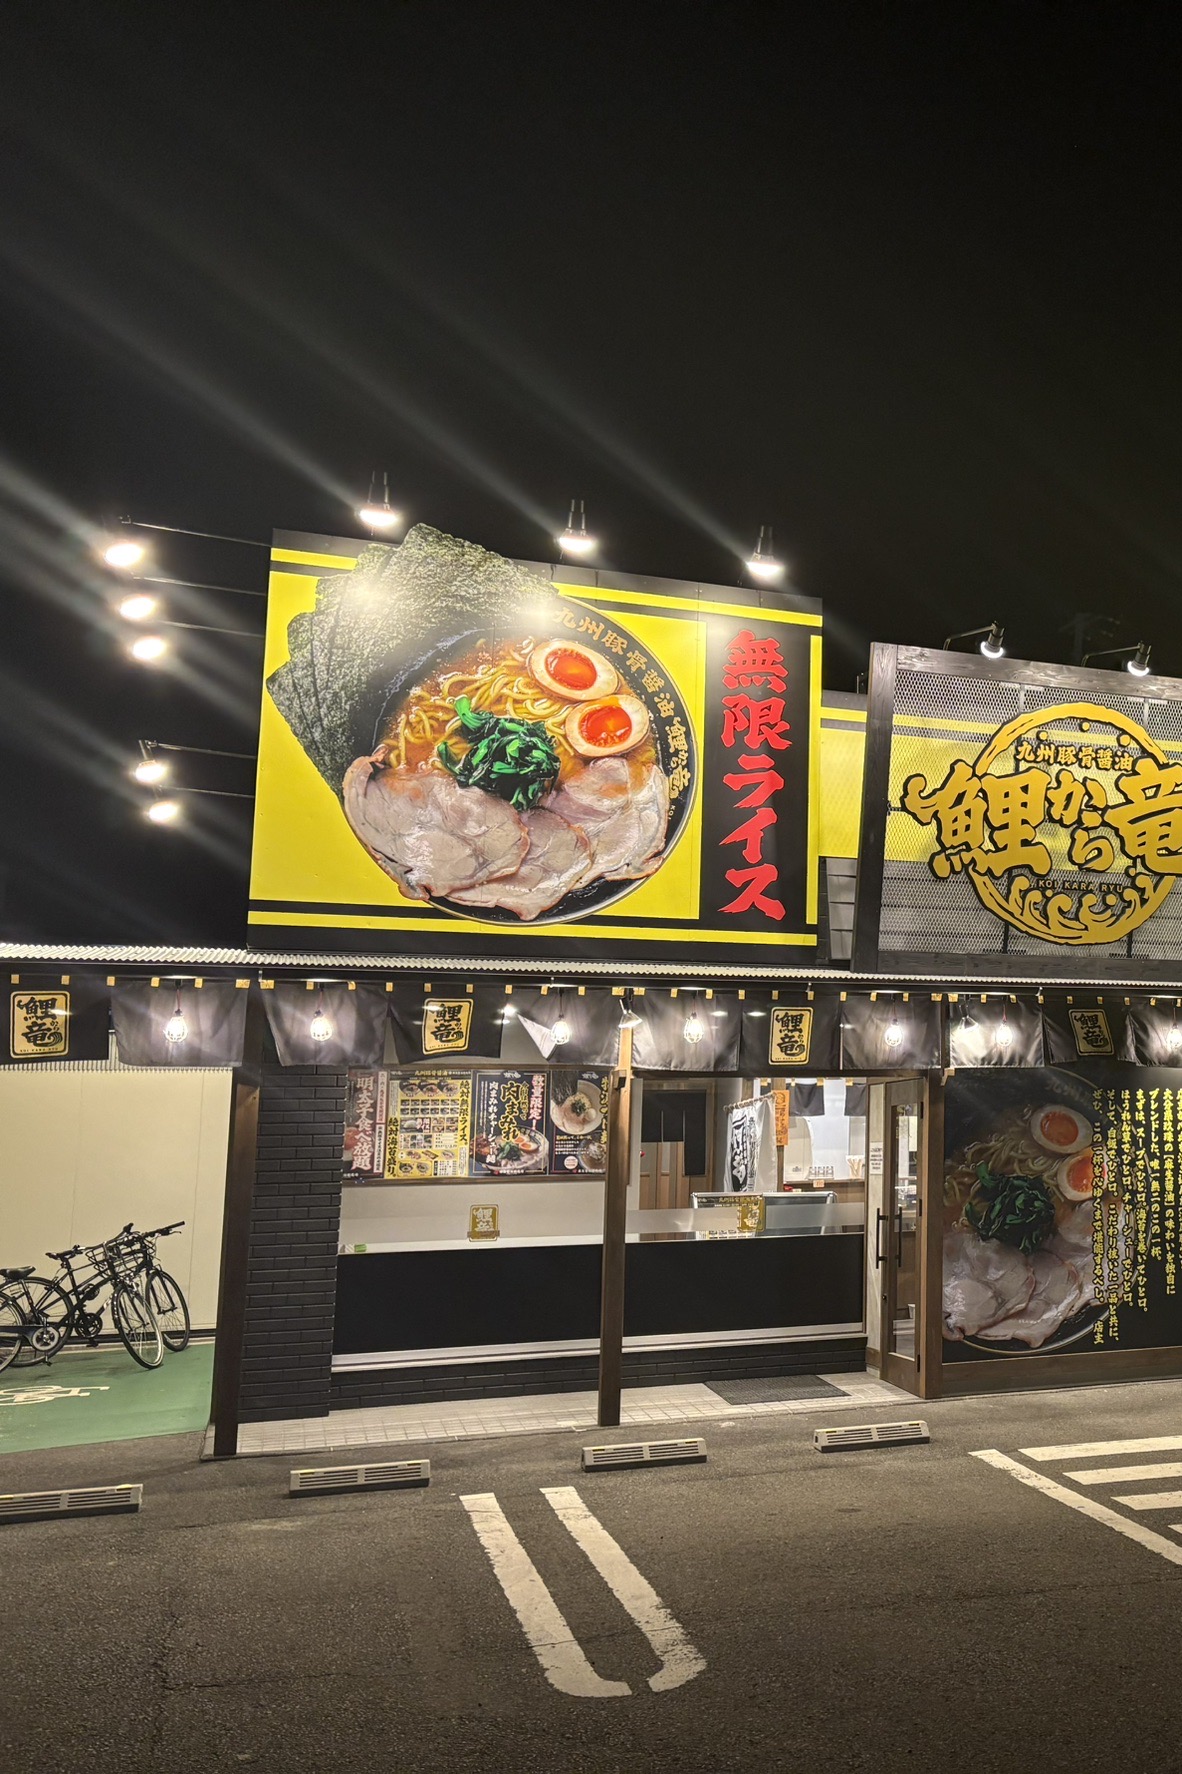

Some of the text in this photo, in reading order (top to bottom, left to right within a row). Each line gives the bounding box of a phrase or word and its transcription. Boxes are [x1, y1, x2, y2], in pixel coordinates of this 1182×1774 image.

[719, 629, 793, 922] 無限ライス
[1016, 741, 1134, 772] 九州豚骨醤油
[1038, 879, 1124, 893] KOI KARA RYU
[351, 1076, 375, 1171] 明太子食べ放題
[499, 1080, 521, 1141] 肉まみれ
